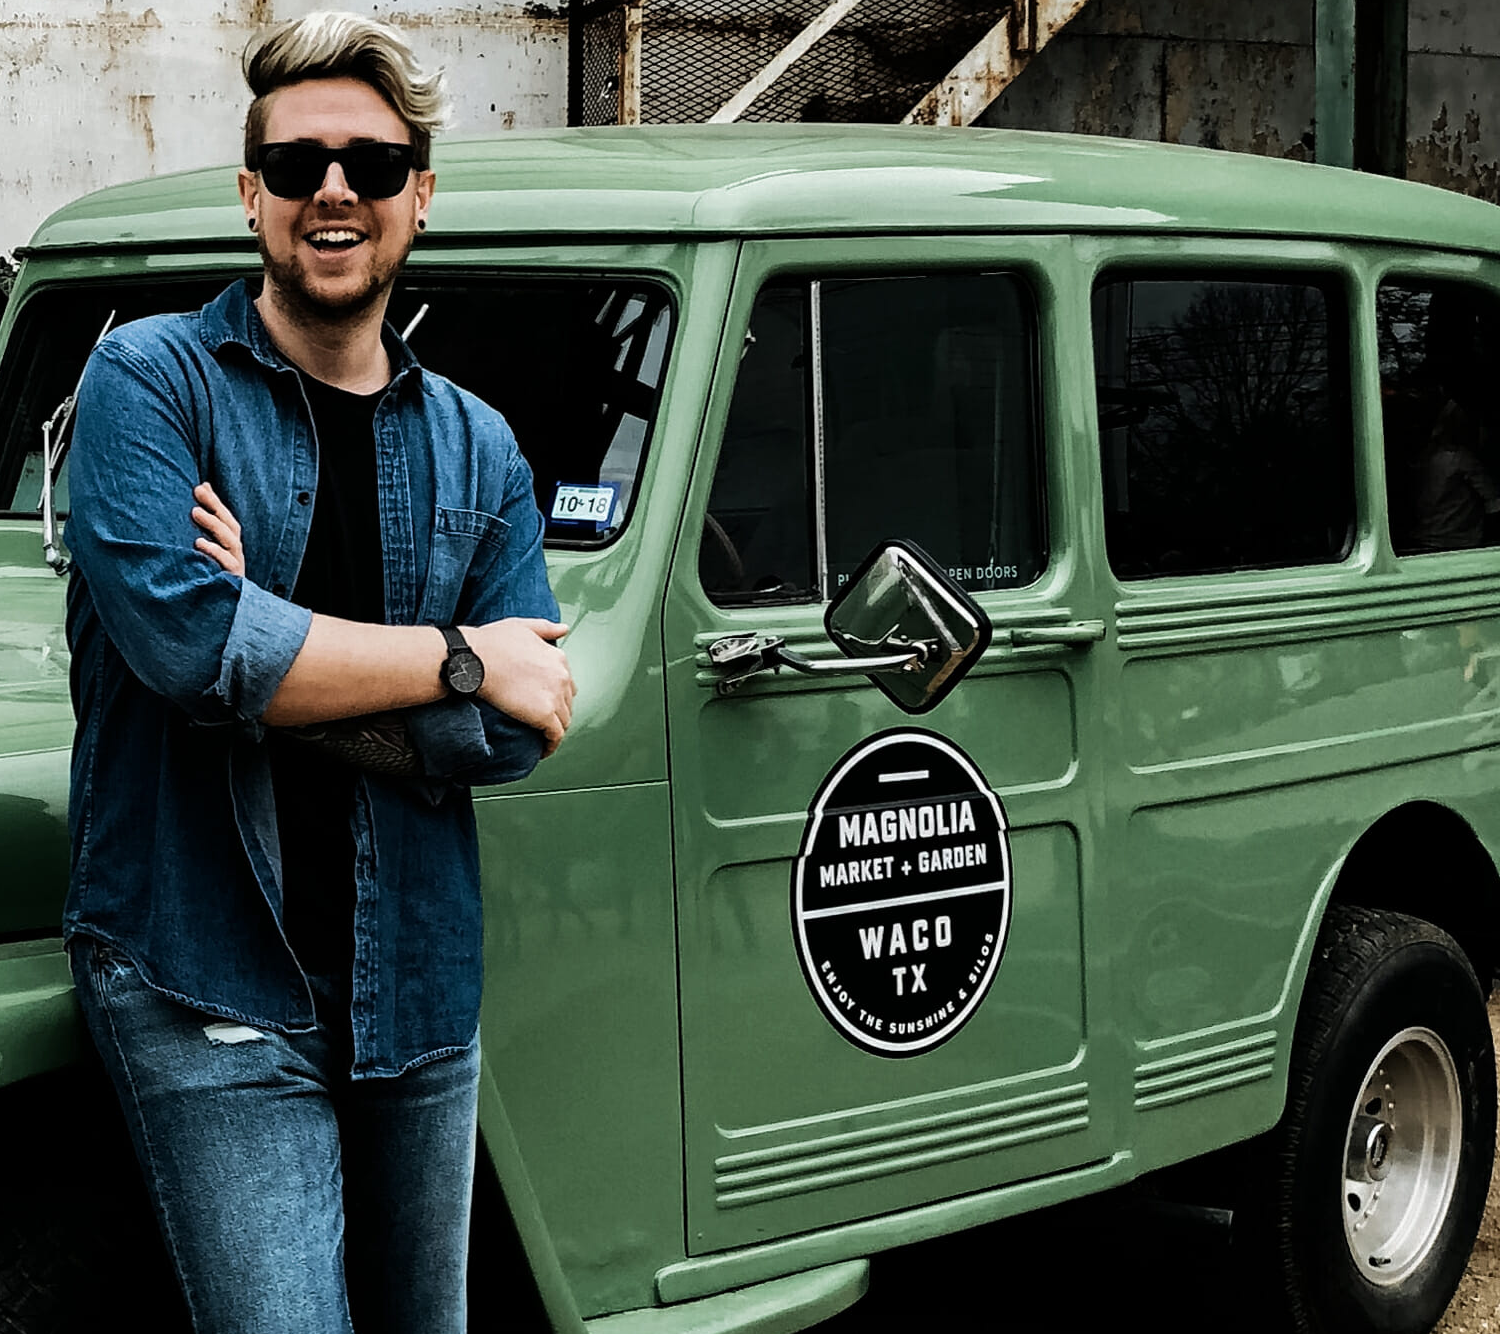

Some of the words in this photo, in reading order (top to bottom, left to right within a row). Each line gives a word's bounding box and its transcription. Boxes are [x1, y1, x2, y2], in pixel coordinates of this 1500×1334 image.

[943, 567, 973, 581] PEN
[976, 565, 1018, 580] DOORS
[838, 800, 976, 849] MAGNOLIA
[819, 855, 895, 888] MARKET
[900, 860, 912, 876] +
[917, 842, 988, 873] GARDEN
[858, 915, 952, 960] WACO
[821, 960, 856, 1010] ENJOY
[859, 1009, 883, 1031] THE
[889, 1000, 955, 1035] SUNSHINE
[958, 988, 968, 1000] &
[968, 933, 994, 984] SILOS
[892, 963, 928, 996] TX
